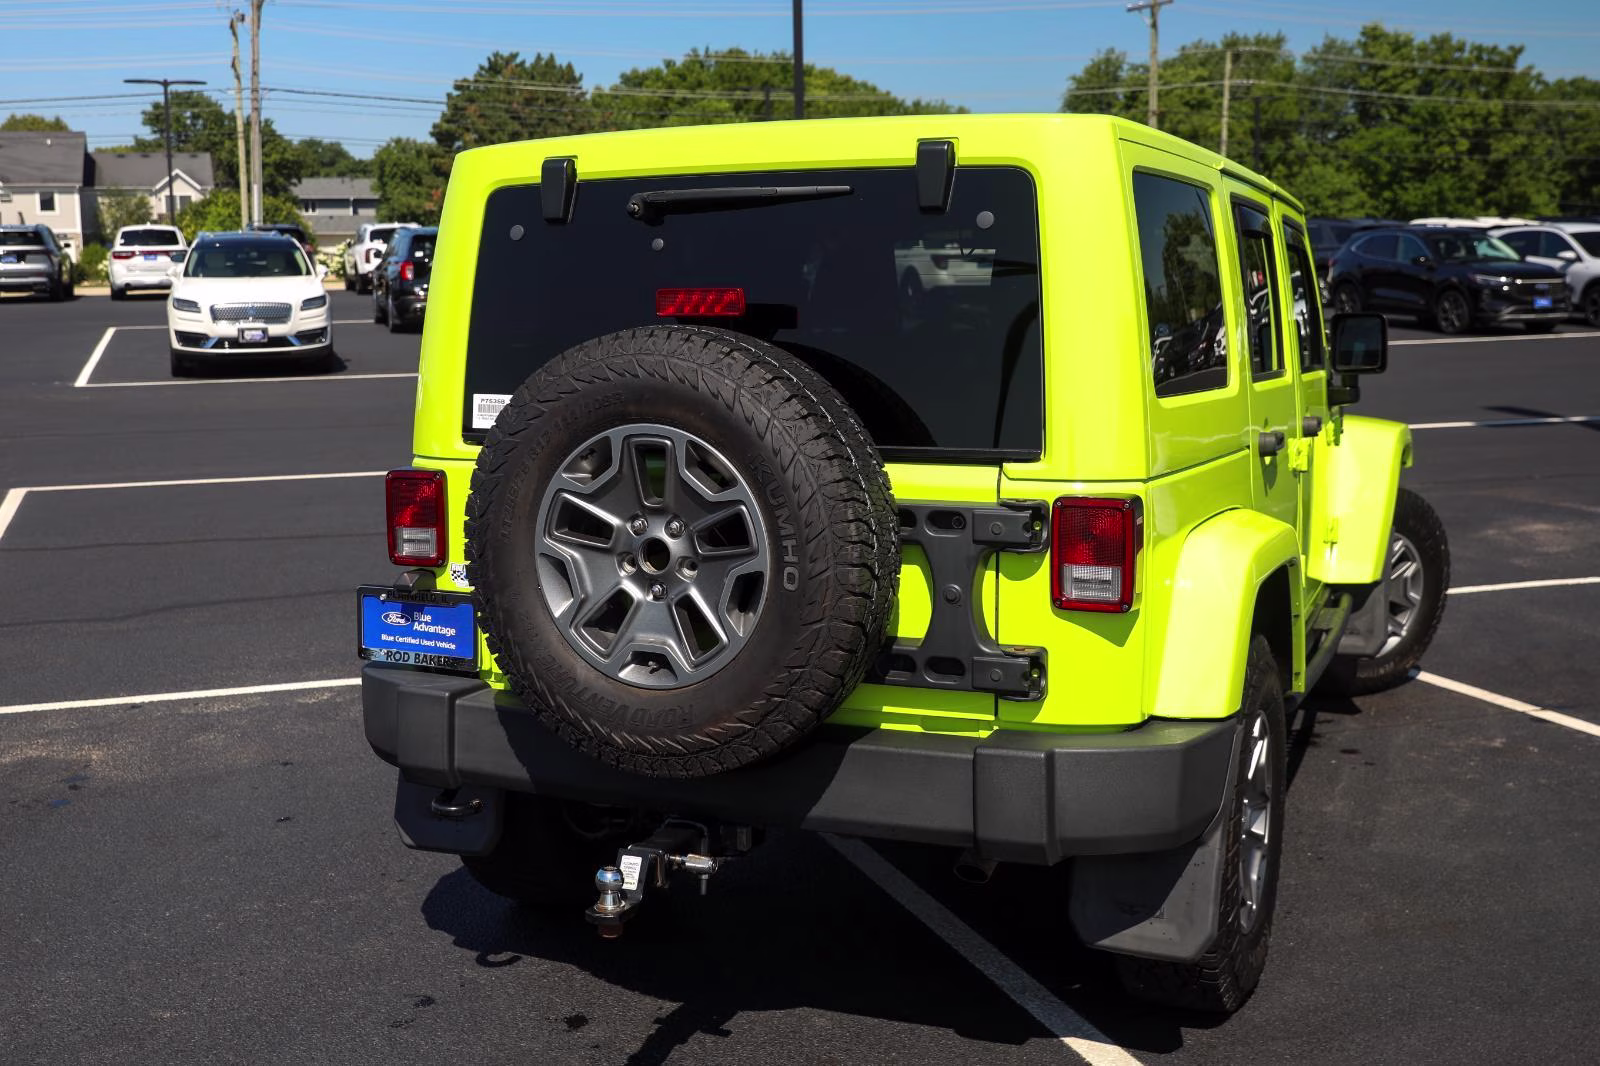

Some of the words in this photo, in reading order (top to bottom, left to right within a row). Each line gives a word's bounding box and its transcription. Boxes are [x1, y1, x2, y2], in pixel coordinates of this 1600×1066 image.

[749, 455, 800, 592] KUMHO
[387, 613, 406, 624] Ford
[413, 611, 432, 622] Blue
[413, 621, 456, 636] Advantage
[381, 633, 394, 642] Blue
[395, 635, 419, 645] Certified
[420, 638, 434, 646] Used
[435, 640, 456, 650] Vehicle
[386, 650, 411, 663] ROD
[413, 652, 449, 667] BAKER
